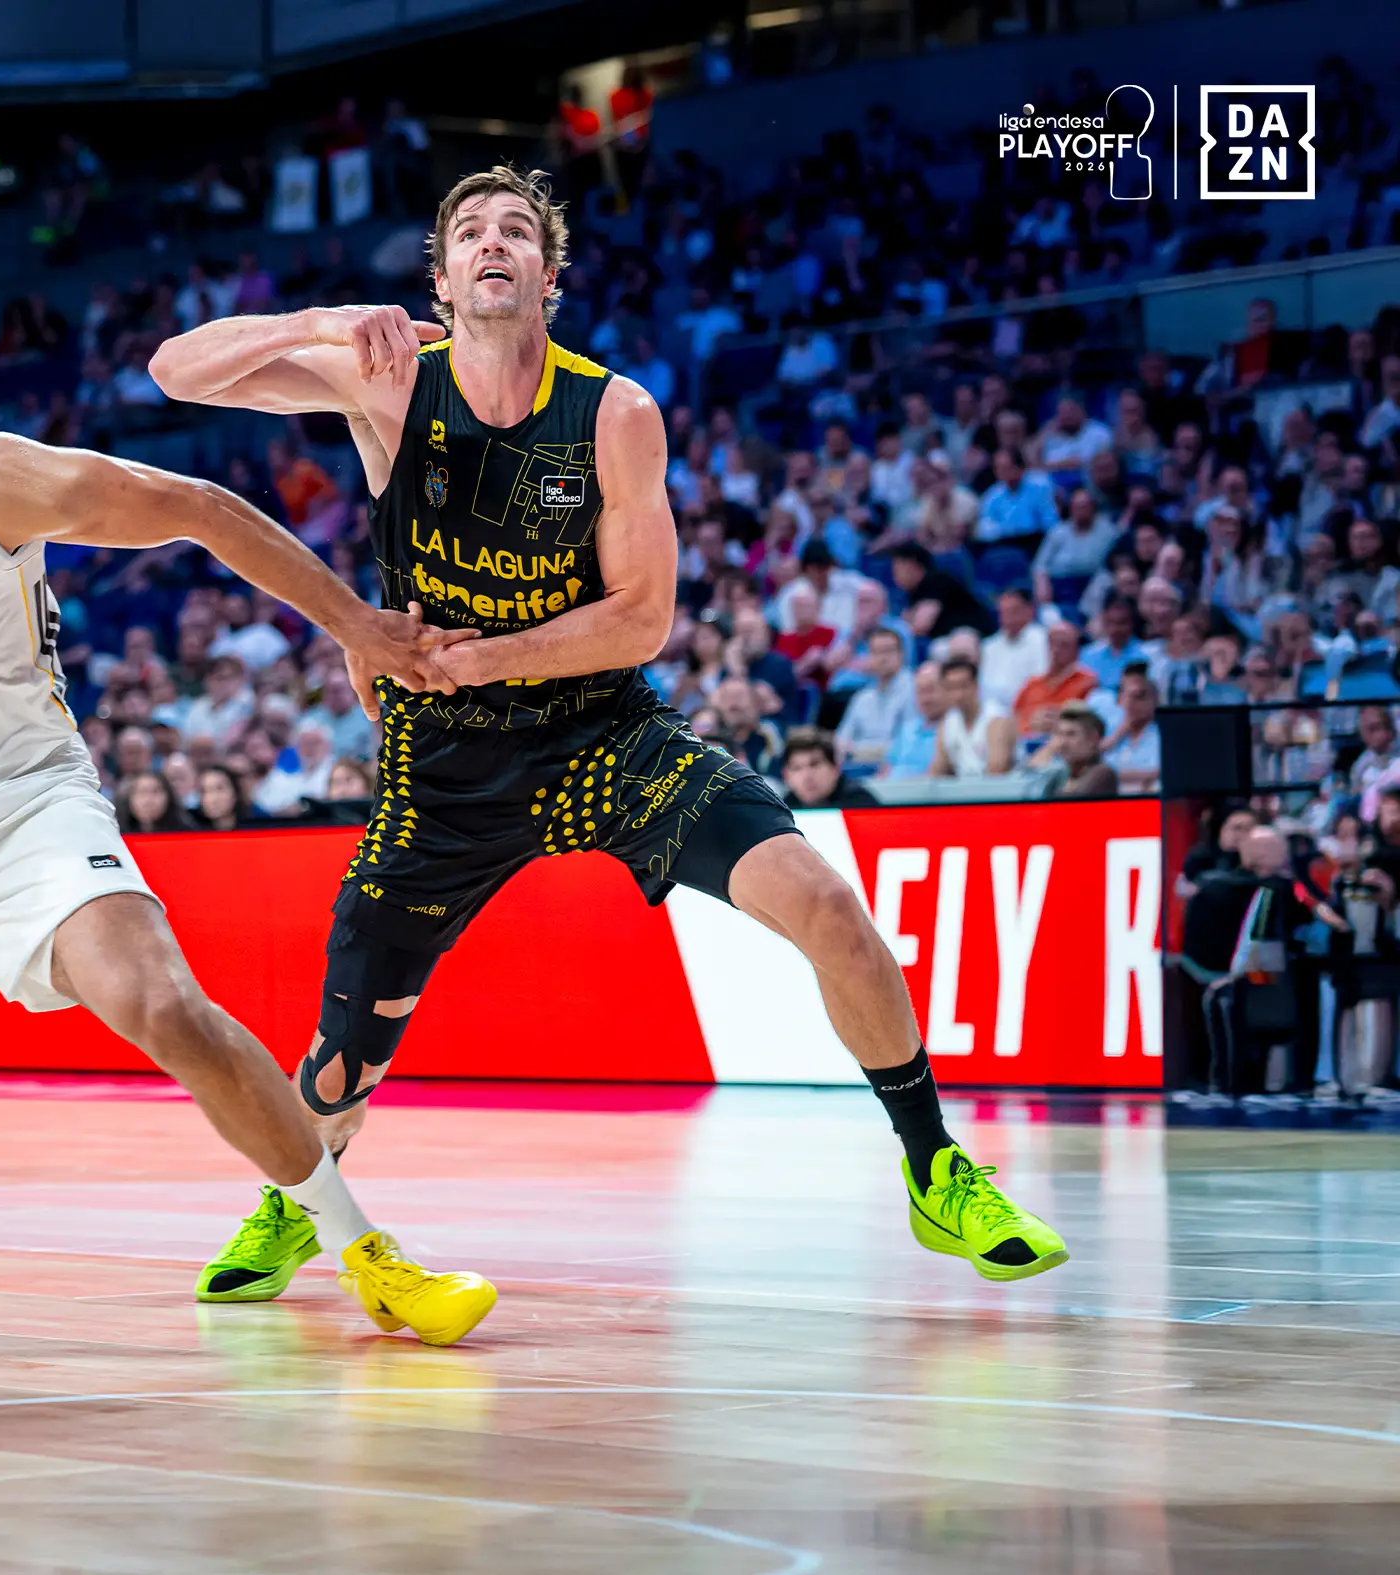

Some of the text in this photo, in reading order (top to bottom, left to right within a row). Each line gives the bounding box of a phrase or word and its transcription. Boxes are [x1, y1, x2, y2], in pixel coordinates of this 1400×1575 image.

[545, 485, 563, 496] liga
[545, 494, 581, 503] endesa
[529, 504, 539, 513] A
[525, 529, 539, 540] Hi
[411, 518, 575, 581] LA LAGUNA
[631, 770, 679, 829] Canarias
[873, 845, 1054, 1057] FLY
